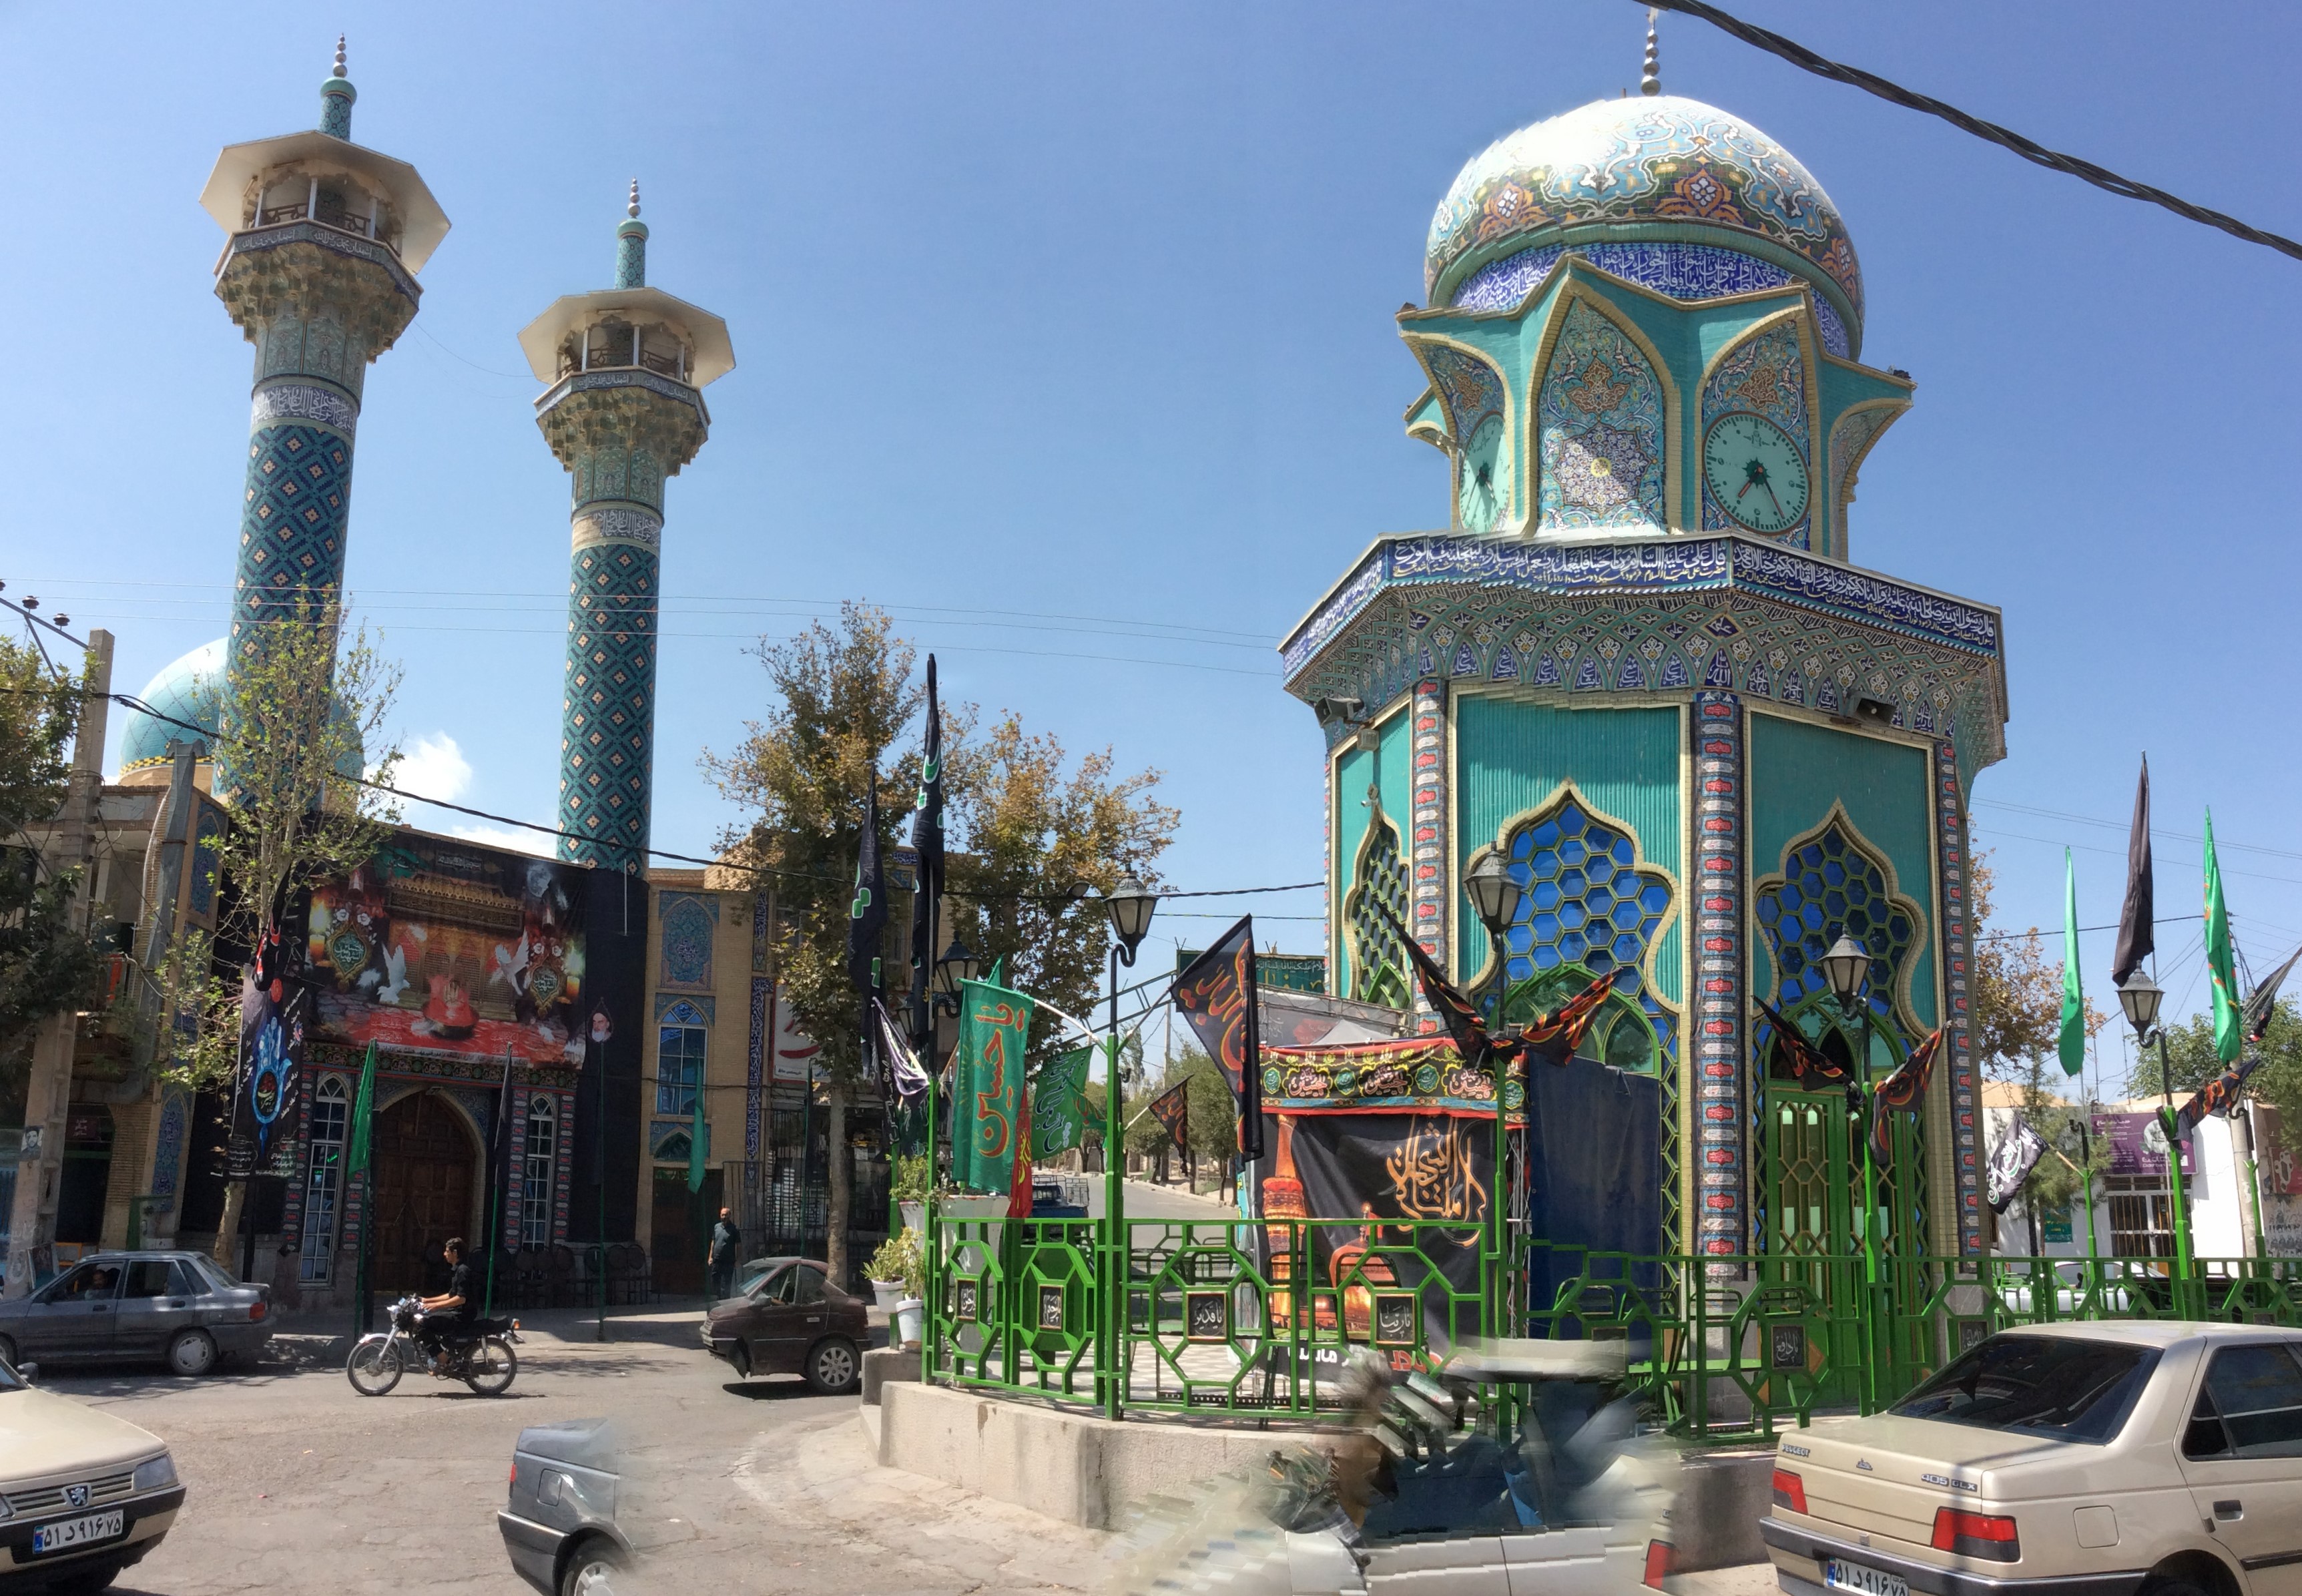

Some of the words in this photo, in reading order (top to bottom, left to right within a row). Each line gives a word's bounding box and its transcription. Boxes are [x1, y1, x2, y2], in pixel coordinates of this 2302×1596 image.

[1782, 1444, 1811, 1458] PEUGEOT
[1921, 1473, 1949, 1487] 405
[1950, 1479, 1978, 1493] GLX
